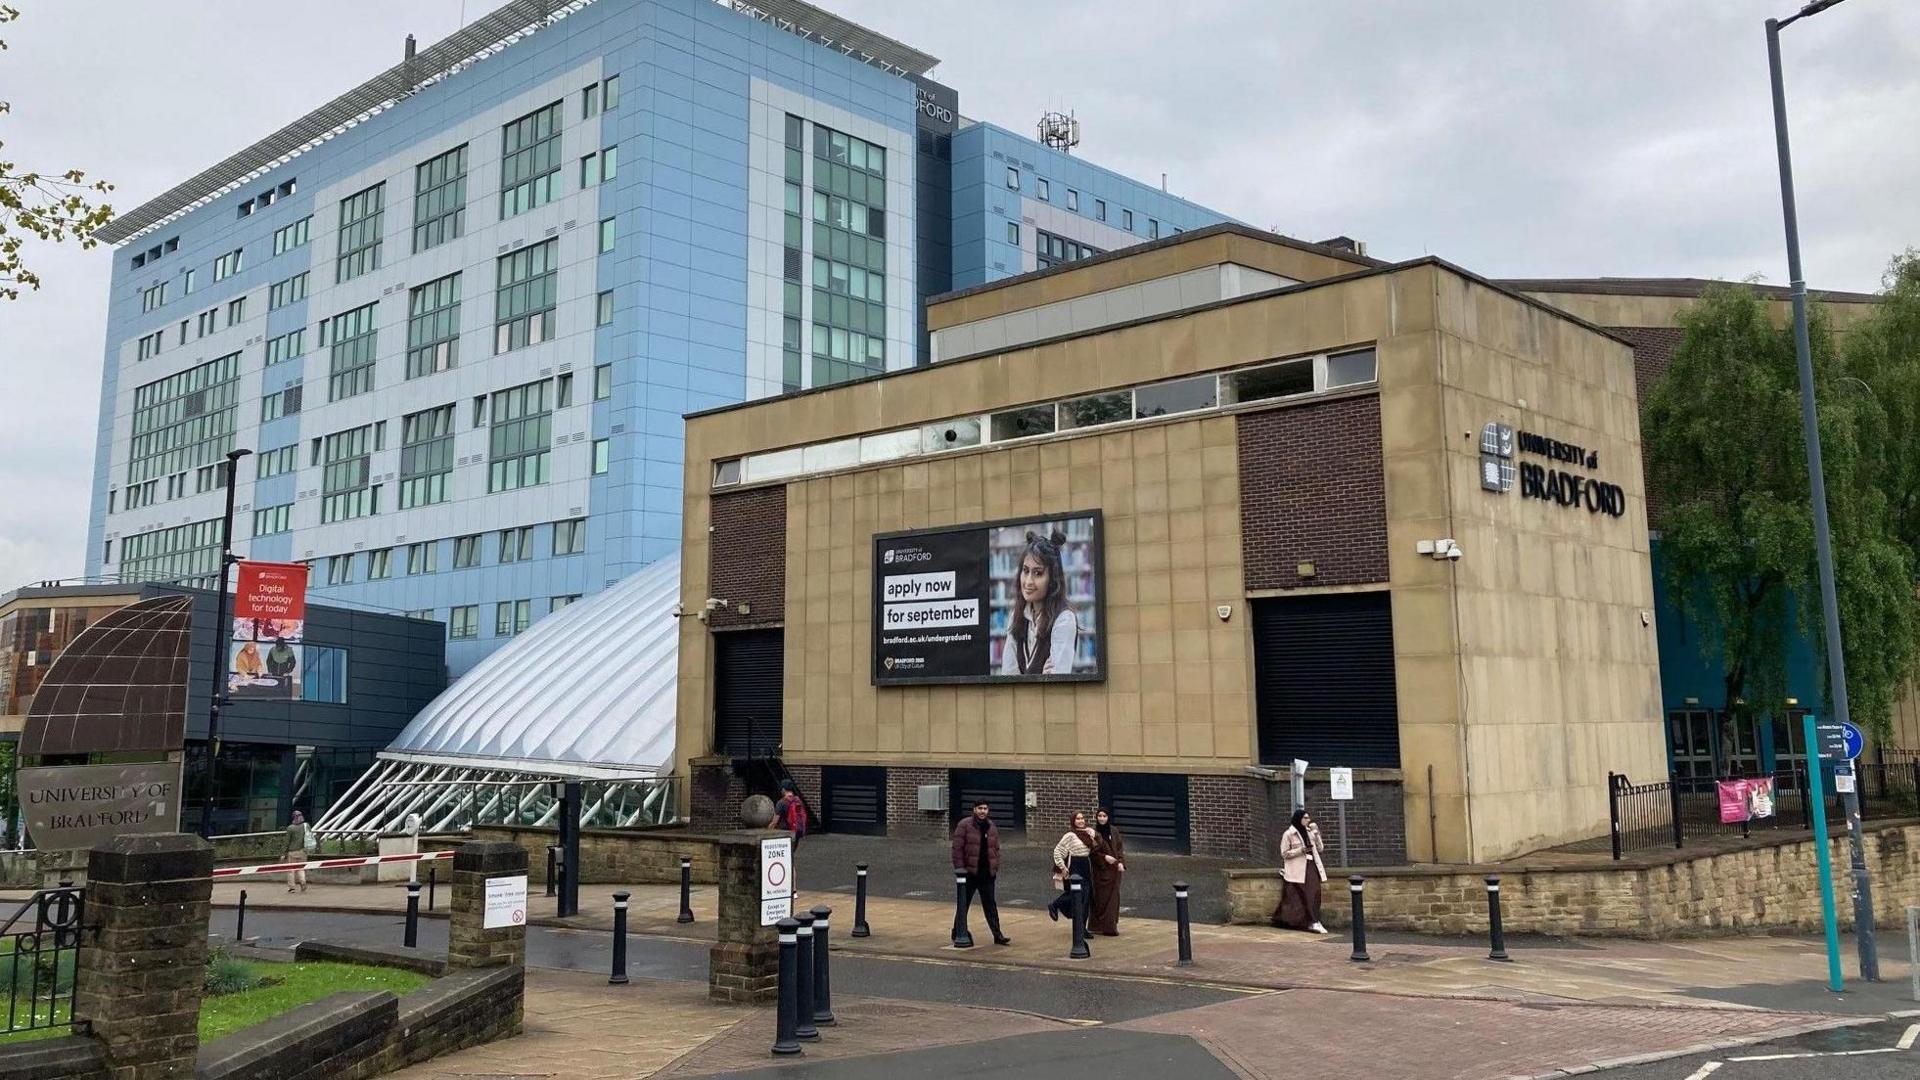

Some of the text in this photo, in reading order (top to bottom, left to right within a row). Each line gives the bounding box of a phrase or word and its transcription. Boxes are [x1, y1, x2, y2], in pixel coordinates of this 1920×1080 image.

[1518, 430, 1598, 469] UNIVERSITY of
[1520, 461, 1625, 518] BRADFORD
[895, 552, 932, 563] BRADFORD
[259, 584, 284, 593] Digital
[888, 579, 952, 598] apply now
[248, 594, 293, 604] technology
[252, 603, 289, 614] for today
[887, 604, 975, 625] for september
[883, 632, 972, 645] bradford.ac.uk/undergraduate
[148, 783, 171, 798] OF
[768, 850, 785, 859] ZONE
